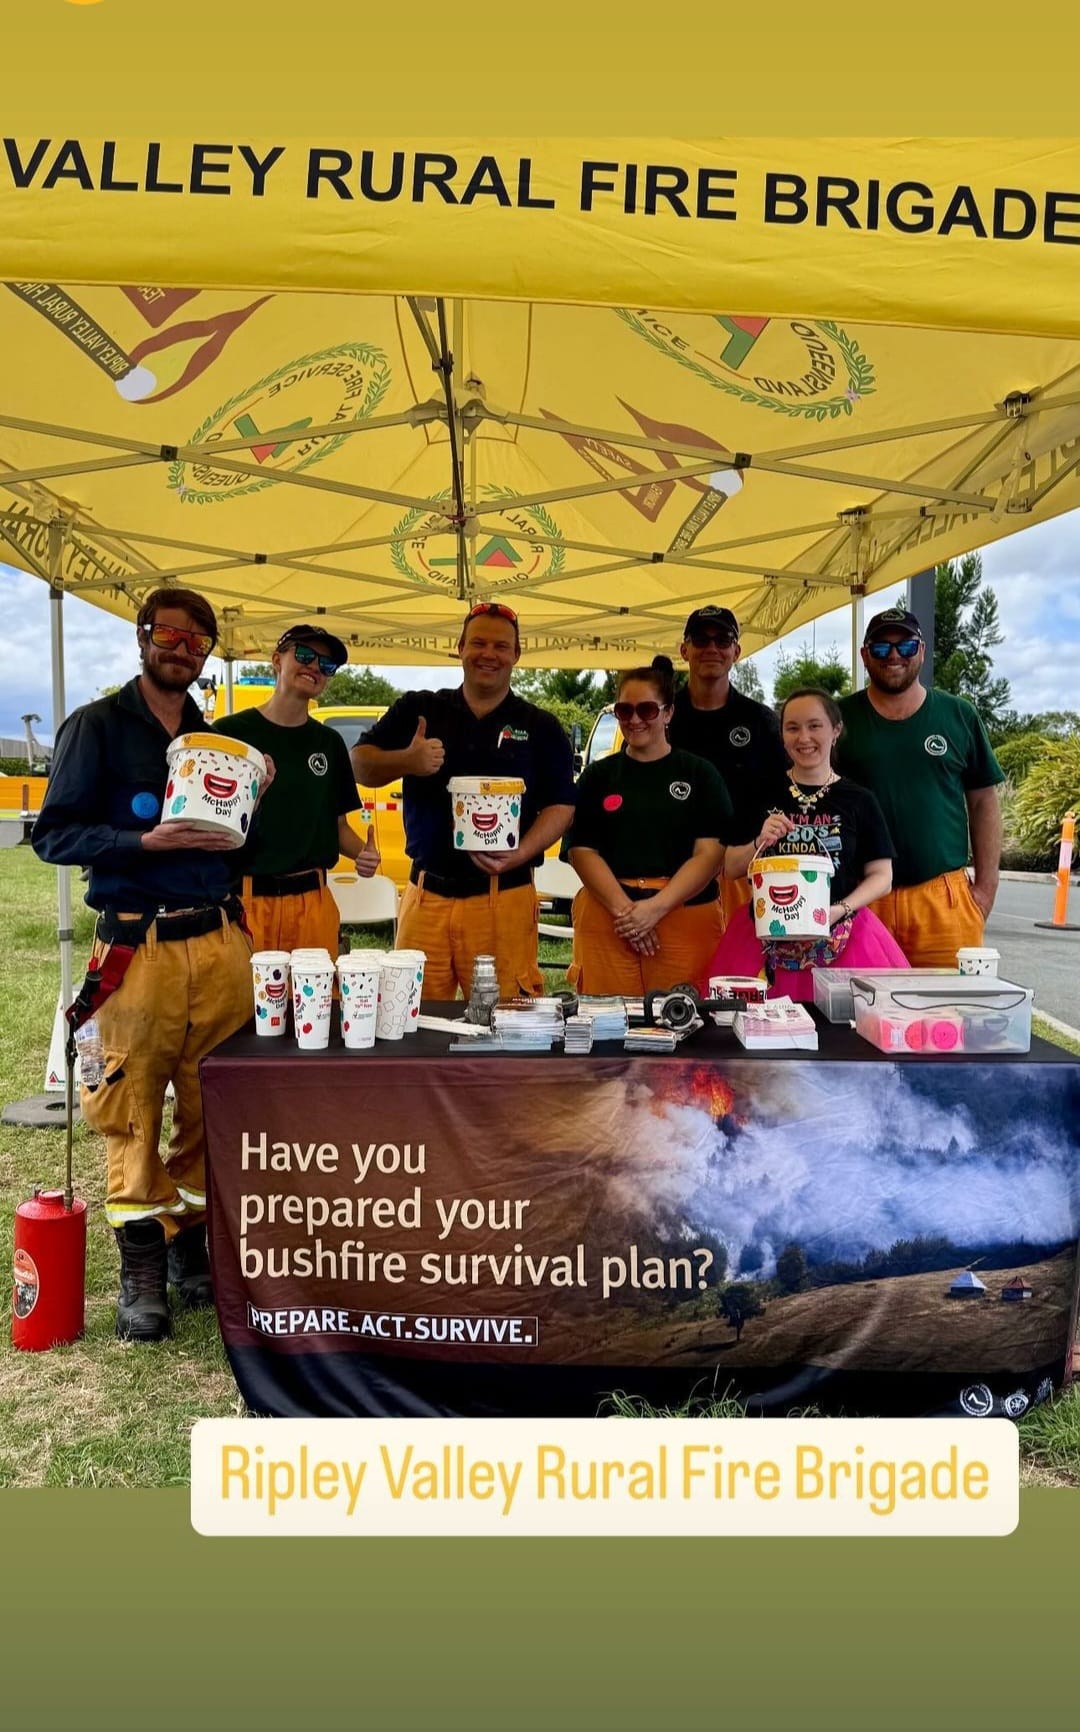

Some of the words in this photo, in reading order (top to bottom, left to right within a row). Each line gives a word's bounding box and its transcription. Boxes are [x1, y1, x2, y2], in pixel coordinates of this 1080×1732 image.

[4, 138, 286, 196] VALLEY
[306, 148, 555, 209] RURAL
[580, 161, 738, 221] FIRE
[764, 172, 1080, 245] BRIGADE
[201, 793, 241, 810] McHappy
[215, 806, 232, 817] Day
[790, 813, 810, 826] I'M
[814, 813, 831, 826] AN
[472, 822, 505, 839] McHappy
[484, 836, 499, 846] Day
[779, 842, 817, 853] KINDA
[771, 895, 807, 914] McHappy
[784, 911, 800, 921] Day
[240, 1131, 339, 1173] Have
[351, 1143, 426, 1184] you
[239, 1186, 422, 1235] prepared
[435, 1198, 531, 1240] your
[239, 1235, 407, 1284] bushfire
[419, 1243, 589, 1288] survival
[602, 1244, 714, 1299] plan?
